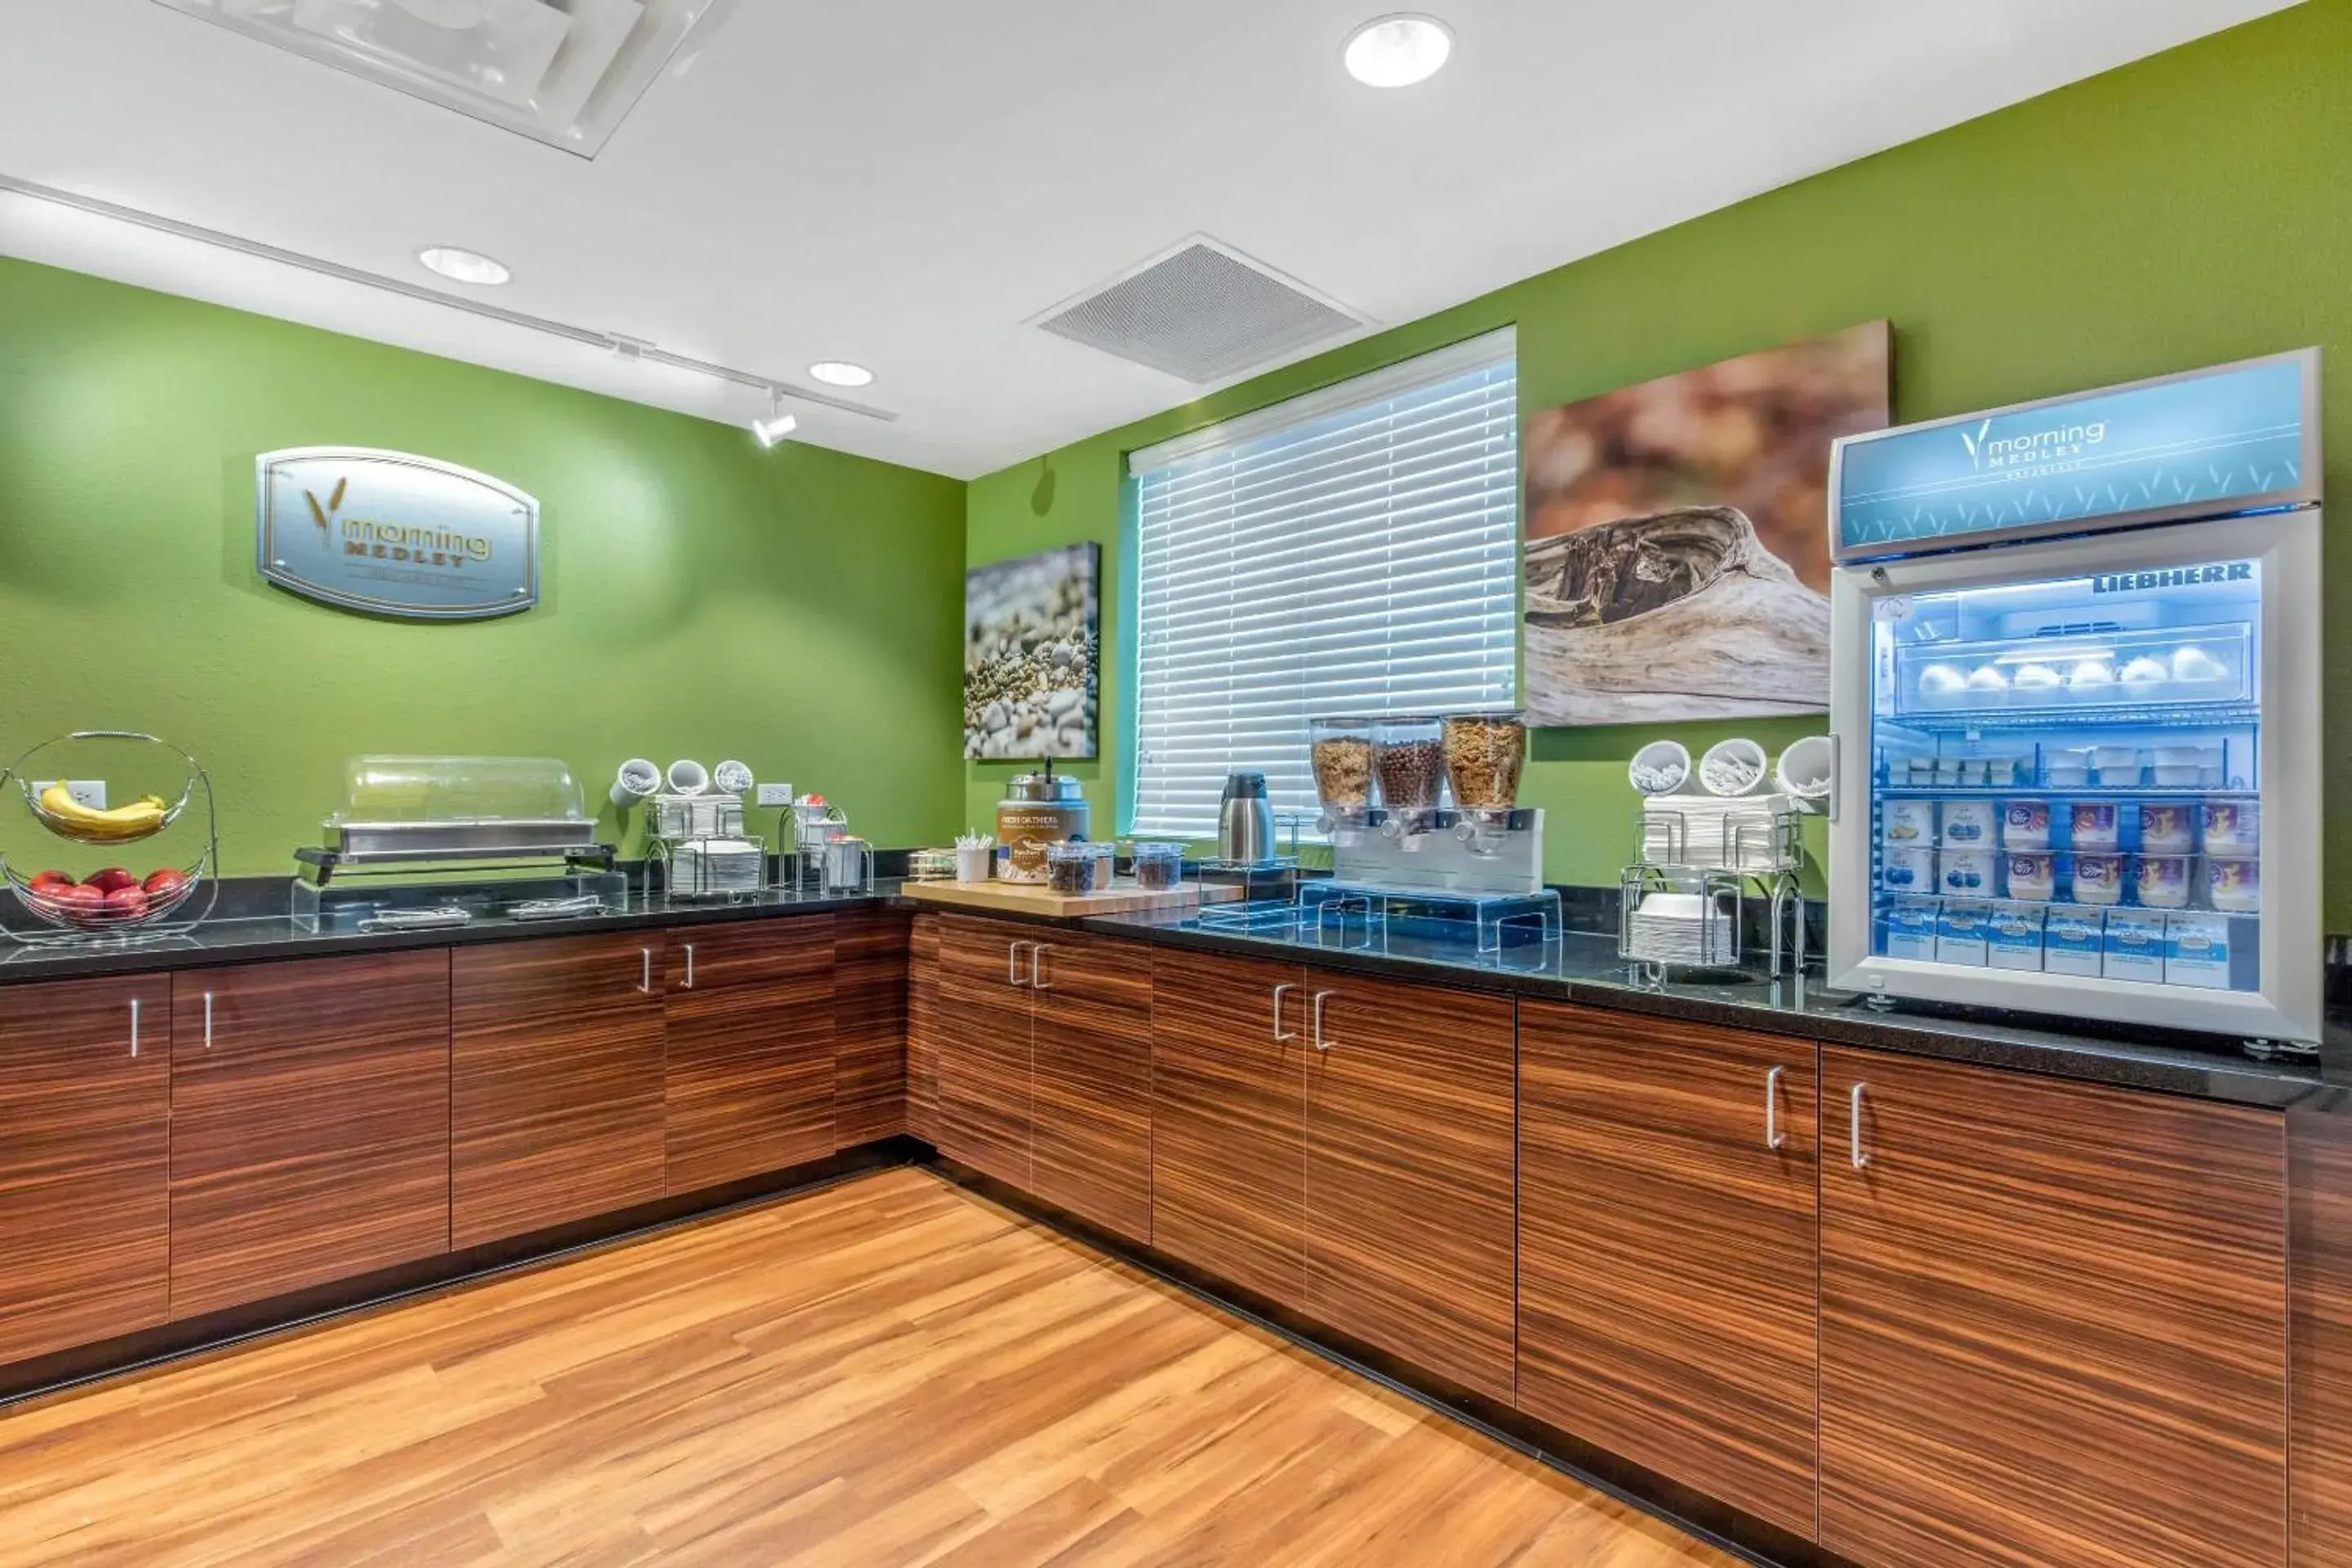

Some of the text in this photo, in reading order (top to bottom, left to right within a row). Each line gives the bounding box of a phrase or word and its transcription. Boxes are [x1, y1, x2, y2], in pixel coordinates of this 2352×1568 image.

[1989, 421, 2105, 456] morning
[1989, 443, 2082, 468] MEDLEY
[342, 519, 492, 561] morning
[344, 541, 465, 568] MEDLEY
[2092, 563, 2252, 594] LIEBHERR
